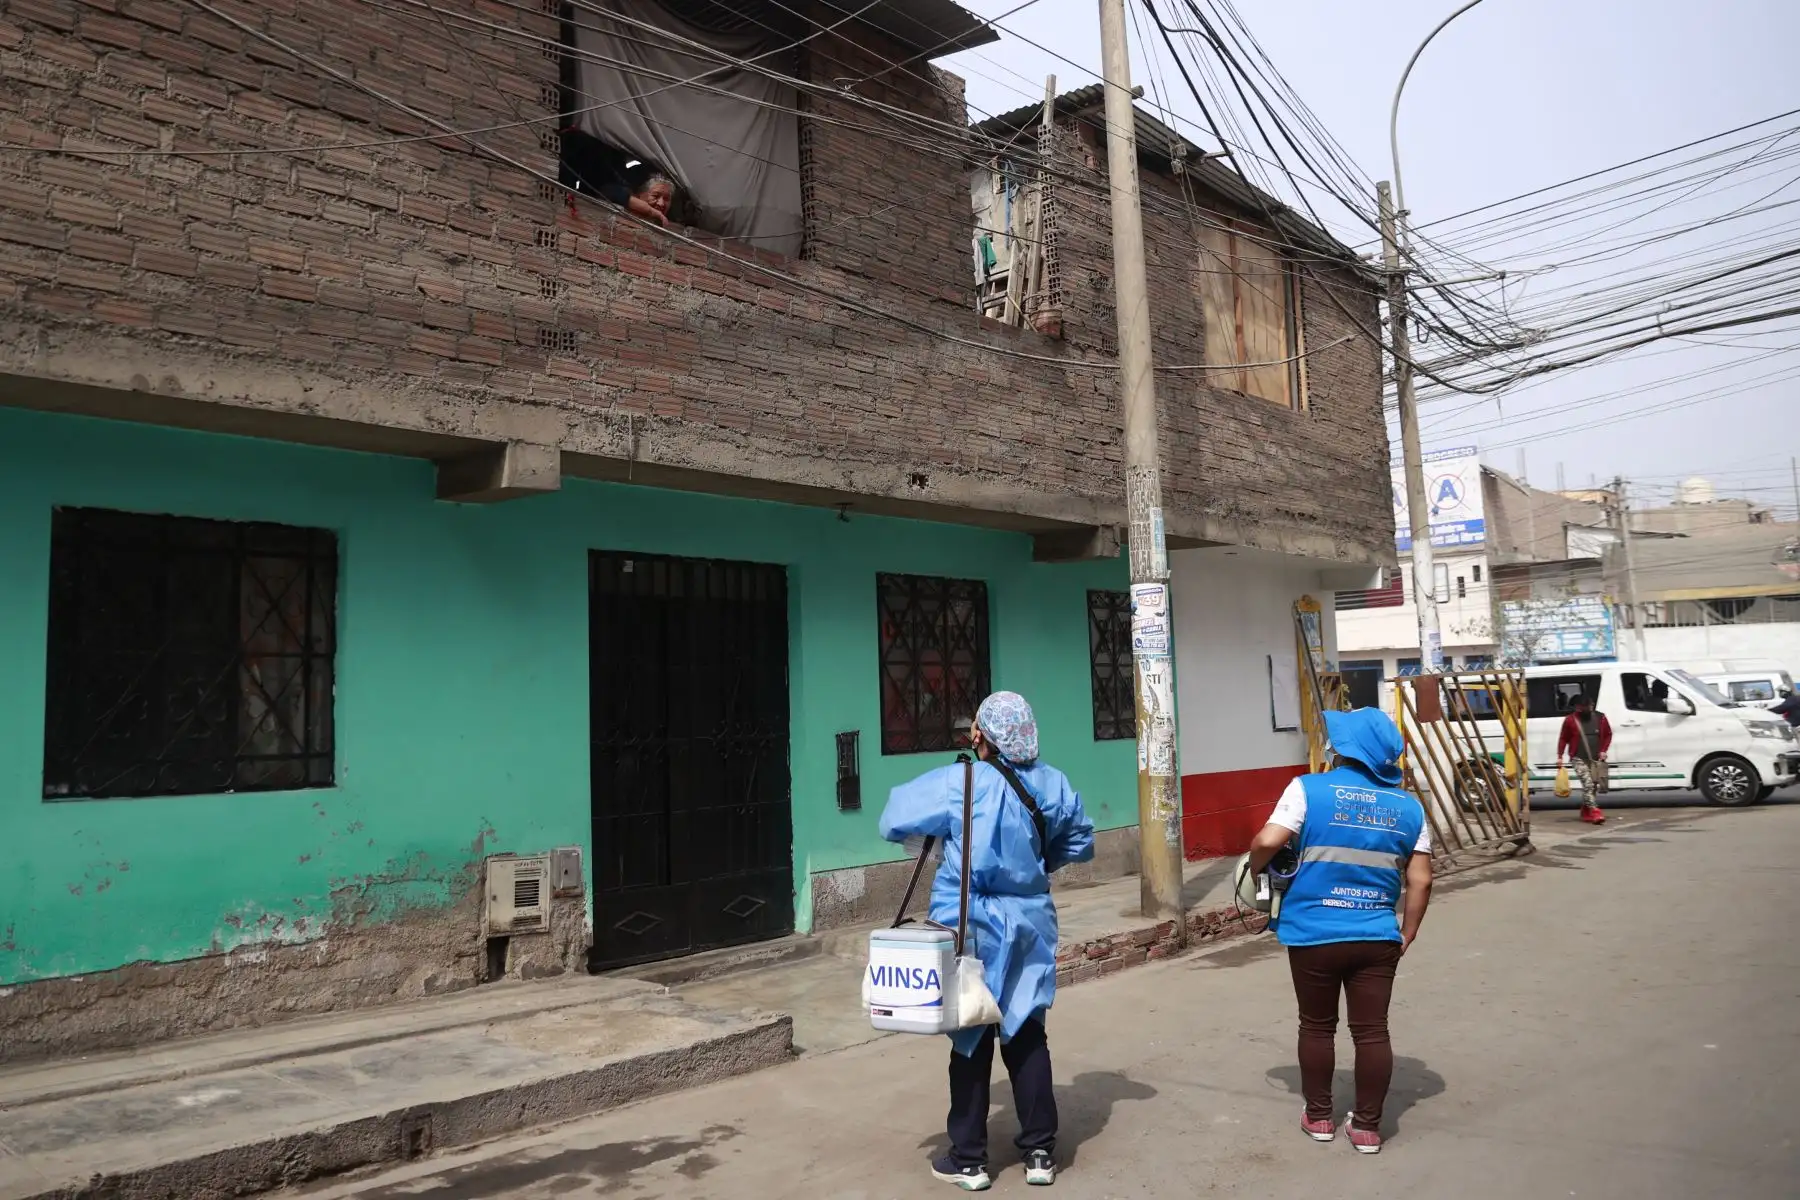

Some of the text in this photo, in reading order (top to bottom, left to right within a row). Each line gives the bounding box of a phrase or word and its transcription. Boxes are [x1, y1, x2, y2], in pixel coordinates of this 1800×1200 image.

[1335, 788, 1377, 803] Comité
[1334, 812, 1397, 827] de SALUD
[1331, 887, 1361, 897] JUNTOS
[1362, 890, 1378, 899] POR
[1322, 899, 1355, 908] DERECHO
[870, 964, 941, 990] MINSA
